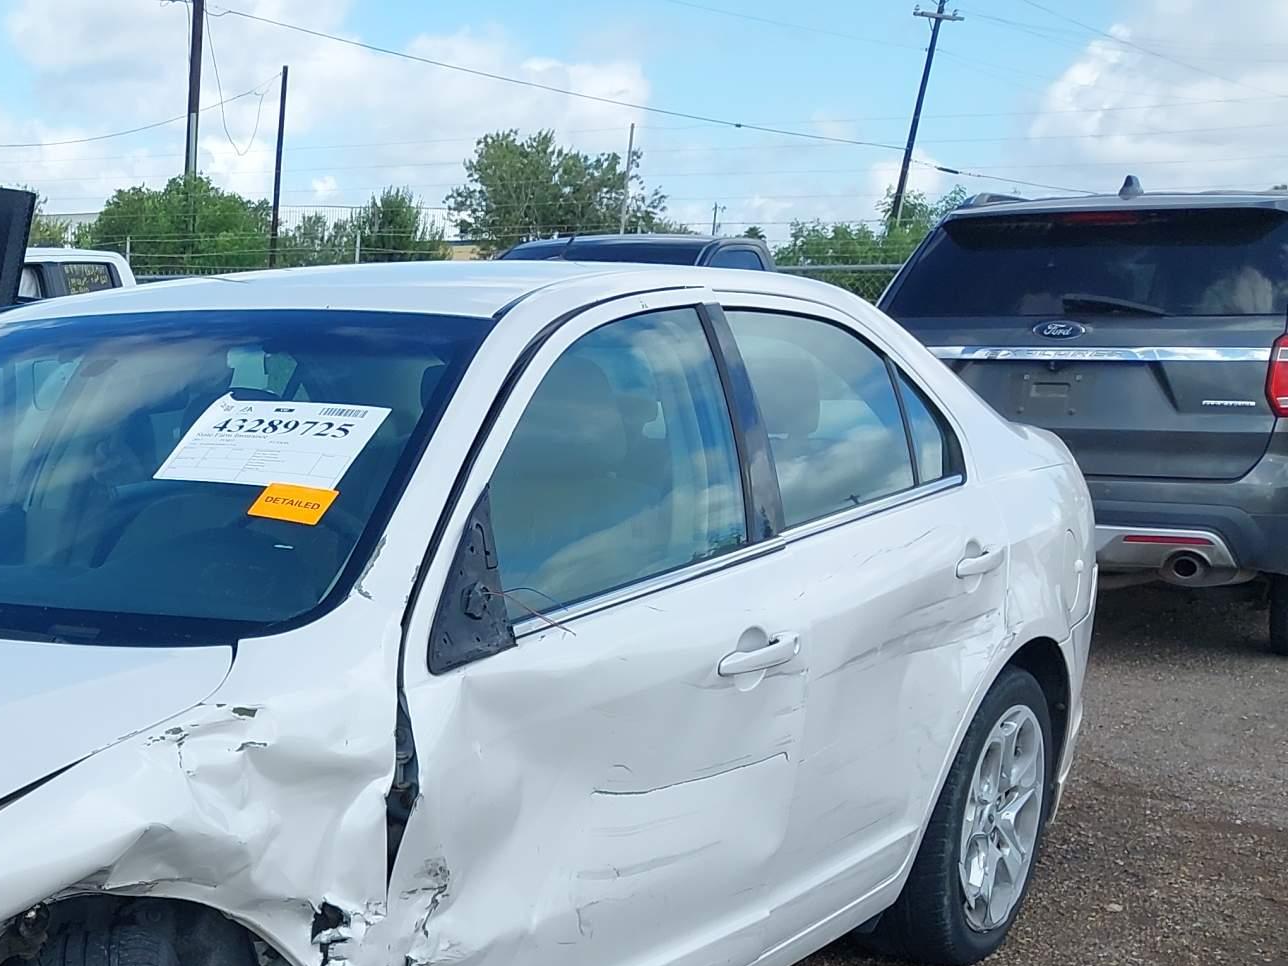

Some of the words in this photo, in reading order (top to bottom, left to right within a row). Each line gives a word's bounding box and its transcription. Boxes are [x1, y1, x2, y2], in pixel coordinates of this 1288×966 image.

[1043, 323, 1073, 336] Ford
[213, 417, 355, 439] 43289725
[264, 496, 321, 510] DETAILED
